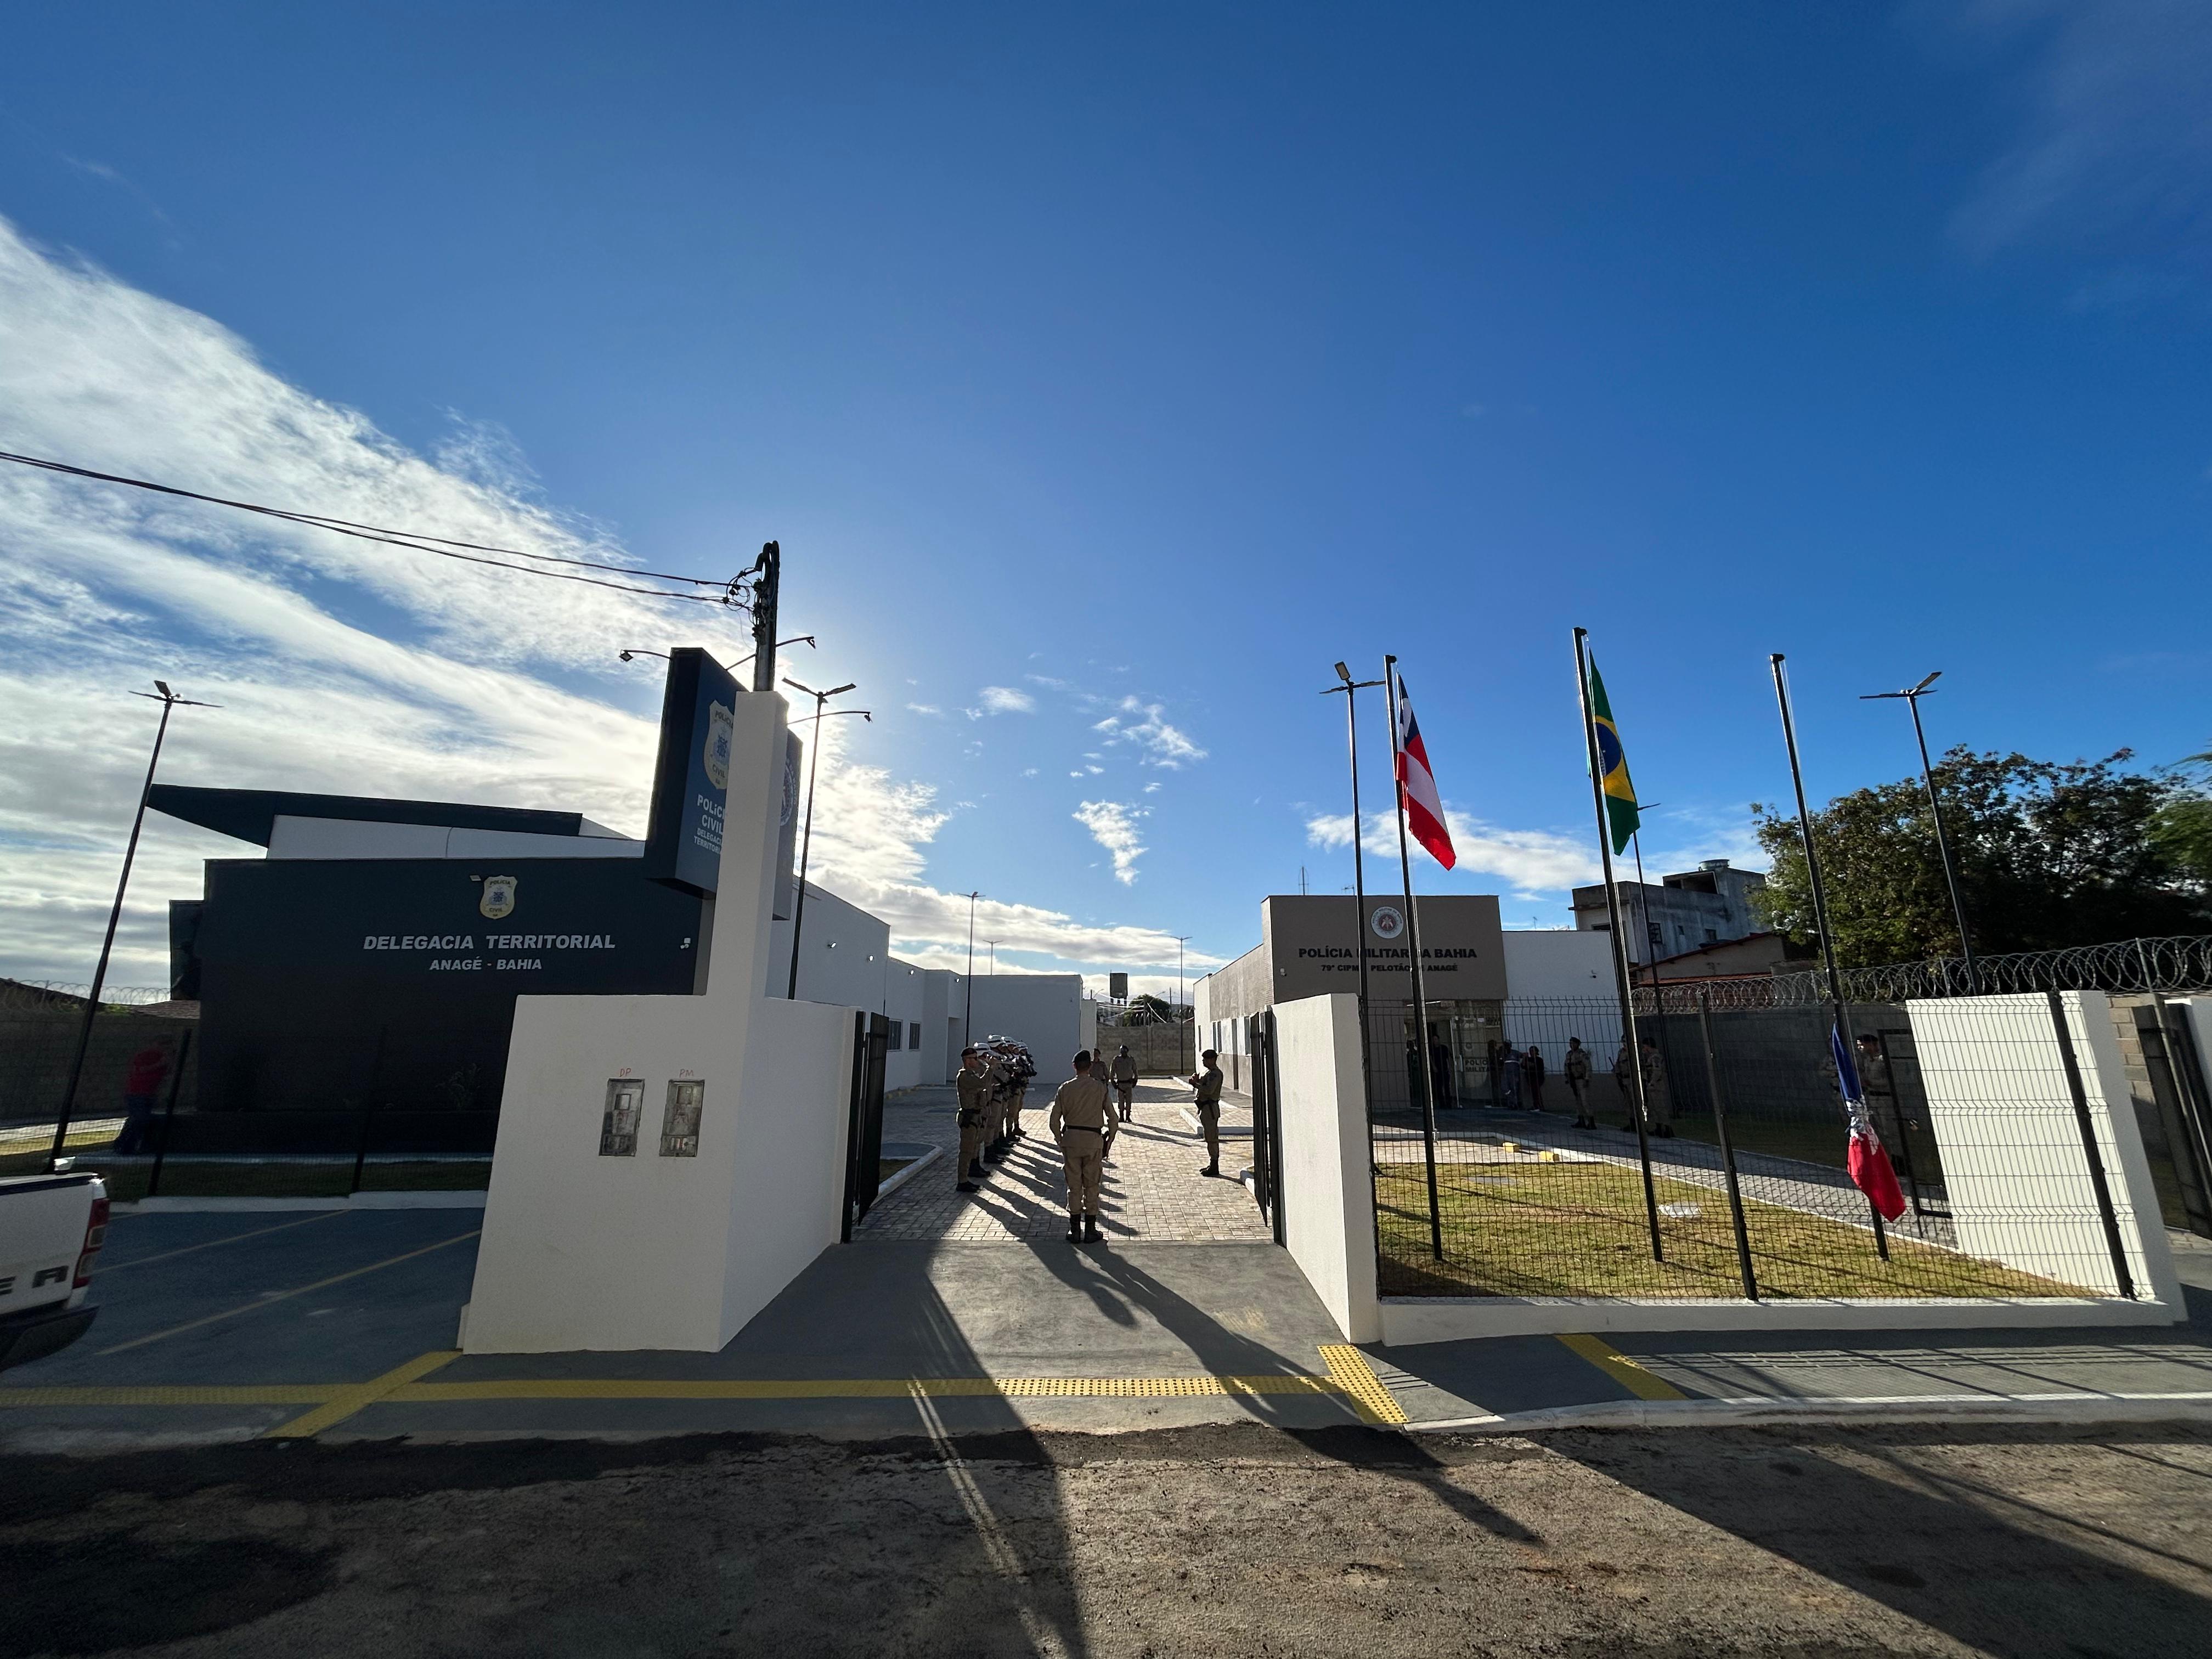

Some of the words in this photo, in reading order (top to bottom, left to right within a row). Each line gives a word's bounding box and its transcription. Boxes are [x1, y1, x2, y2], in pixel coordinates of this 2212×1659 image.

[713, 763, 725, 778] CIVIL
[702, 814, 724, 835] CIVIL
[697, 827, 722, 845] DELEGACI
[363, 936, 474, 950] DELEGACIA
[486, 935, 616, 949] TERRITORIAL
[1299, 945, 1353, 958] POLÍCIA
[1357, 948, 1410, 958] ILITAR
[1434, 949, 1477, 958] BAHIA
[430, 956, 482, 970] ANAGÉ
[496, 958, 542, 970] BAHIA
[1371, 963, 1411, 972] PELOTÃO
[1427, 963, 1458, 972] ANAGÉ
[619, 1068, 631, 1077] DP
[679, 1069, 694, 1077] PM
